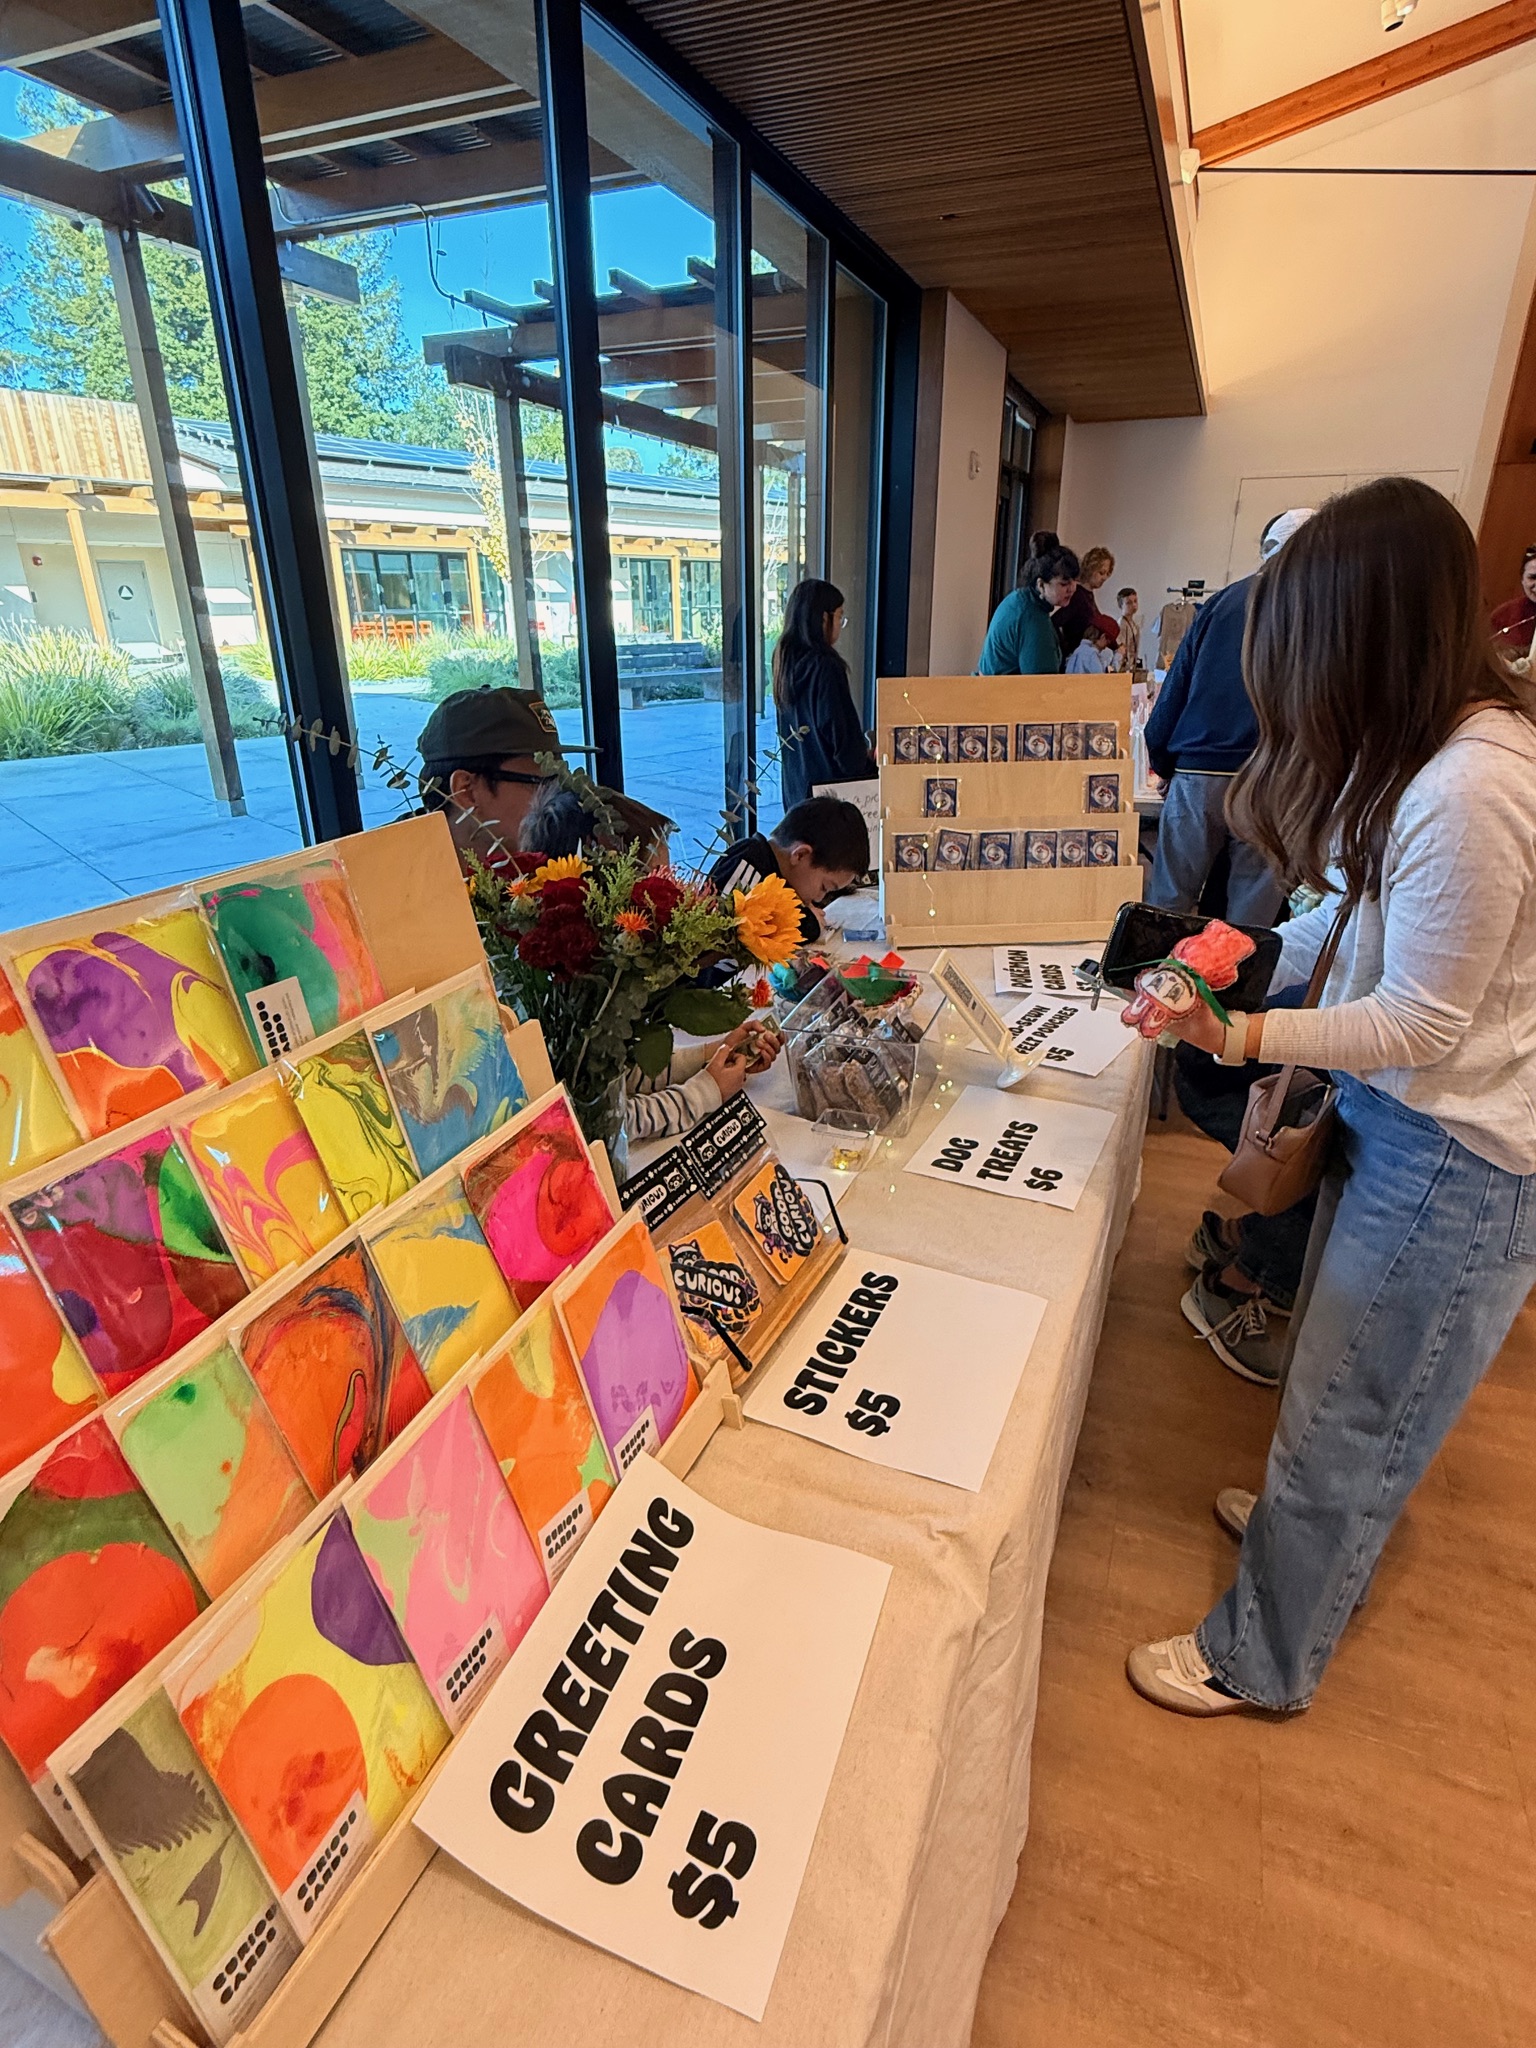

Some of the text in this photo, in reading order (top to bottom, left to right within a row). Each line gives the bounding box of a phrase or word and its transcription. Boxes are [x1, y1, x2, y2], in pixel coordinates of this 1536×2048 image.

[1003, 949, 1033, 989] POKÉMON
[1040, 964, 1067, 991] CARDS
[1015, 1006, 1078, 1055] FELT POUCHES
[1044, 1046, 1075, 1062] $5
[930, 1138, 980, 1173] DOG
[976, 1121, 1039, 1182] TREATS
[641, 1188, 664, 1212] URIOUS
[1023, 1167, 1062, 1192] $6
[674, 1269, 741, 1305] CURIOUS
[783, 1271, 899, 1416] STICKERS
[844, 1388, 901, 1437] $5
[545, 1503, 584, 1547] CURIOUS
[547, 1524, 577, 1559] CARDS
[446, 1627, 493, 1691] CURIOUS
[450, 1652, 487, 1703] CARDS
[489, 1497, 694, 1834] GREETING
[576, 1627, 727, 1886] CARDS
[297, 1809, 357, 1900] CURIOUS
[304, 1842, 349, 1913] CARDS
[667, 1810, 757, 1930] $5
[212, 1903, 278, 1991] CURIOU
[220, 1926, 277, 2004] CARDS
